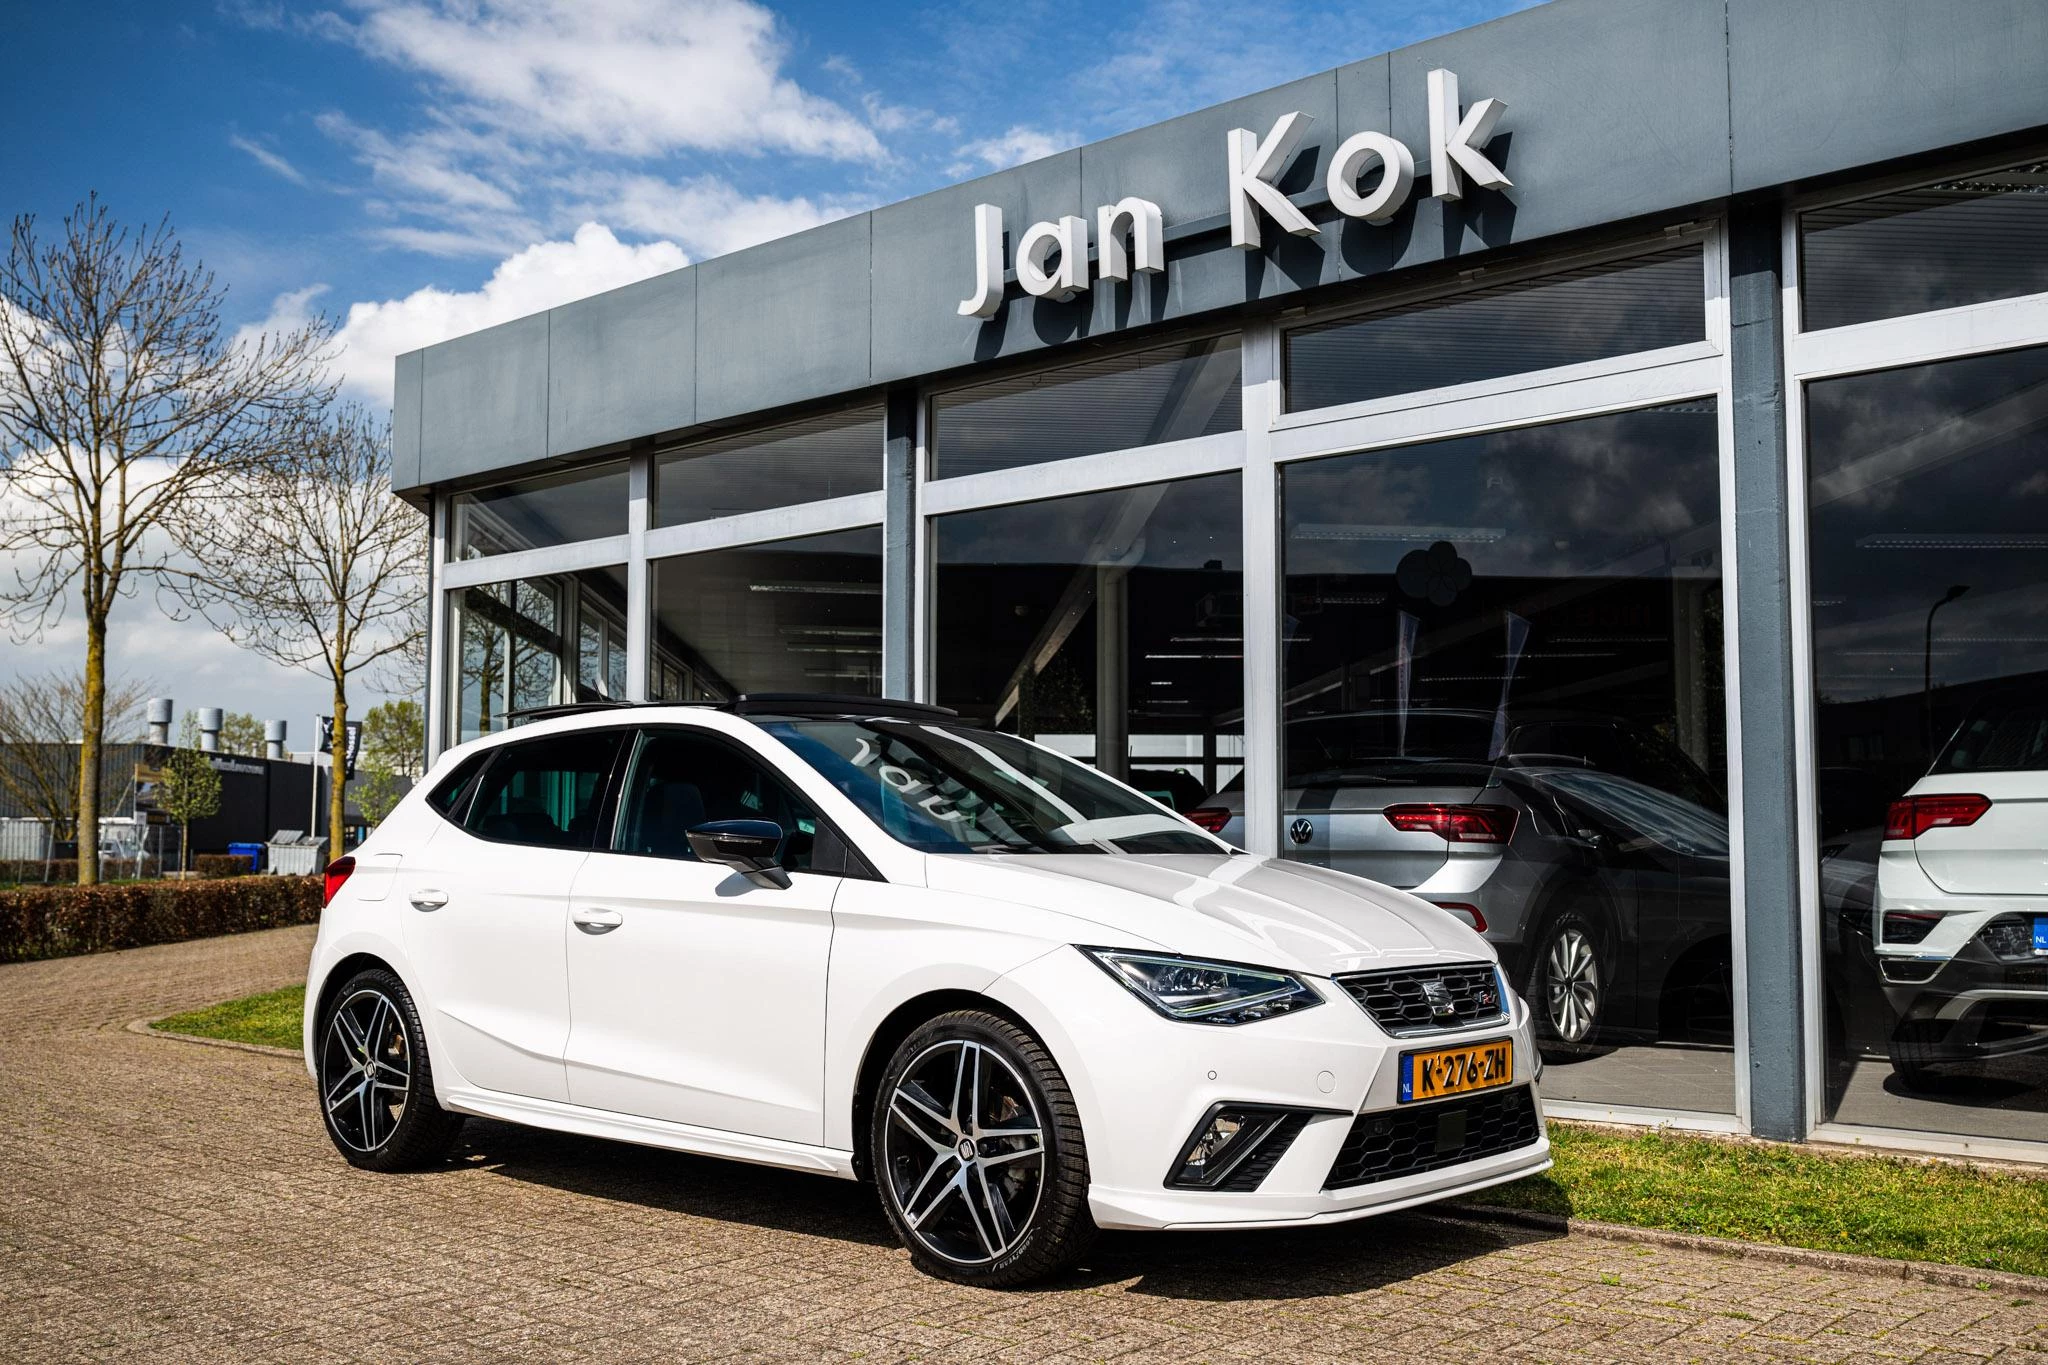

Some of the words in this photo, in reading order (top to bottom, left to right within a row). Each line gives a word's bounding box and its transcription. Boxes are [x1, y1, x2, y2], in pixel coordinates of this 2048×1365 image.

[957, 196, 1164, 321] Jan
[1227, 68, 1514, 250] Kok
[2035, 935, 2047, 944] NL
[1422, 1047, 1506, 1092] K-276-ZH
[1402, 1083, 1412, 1093] NL
